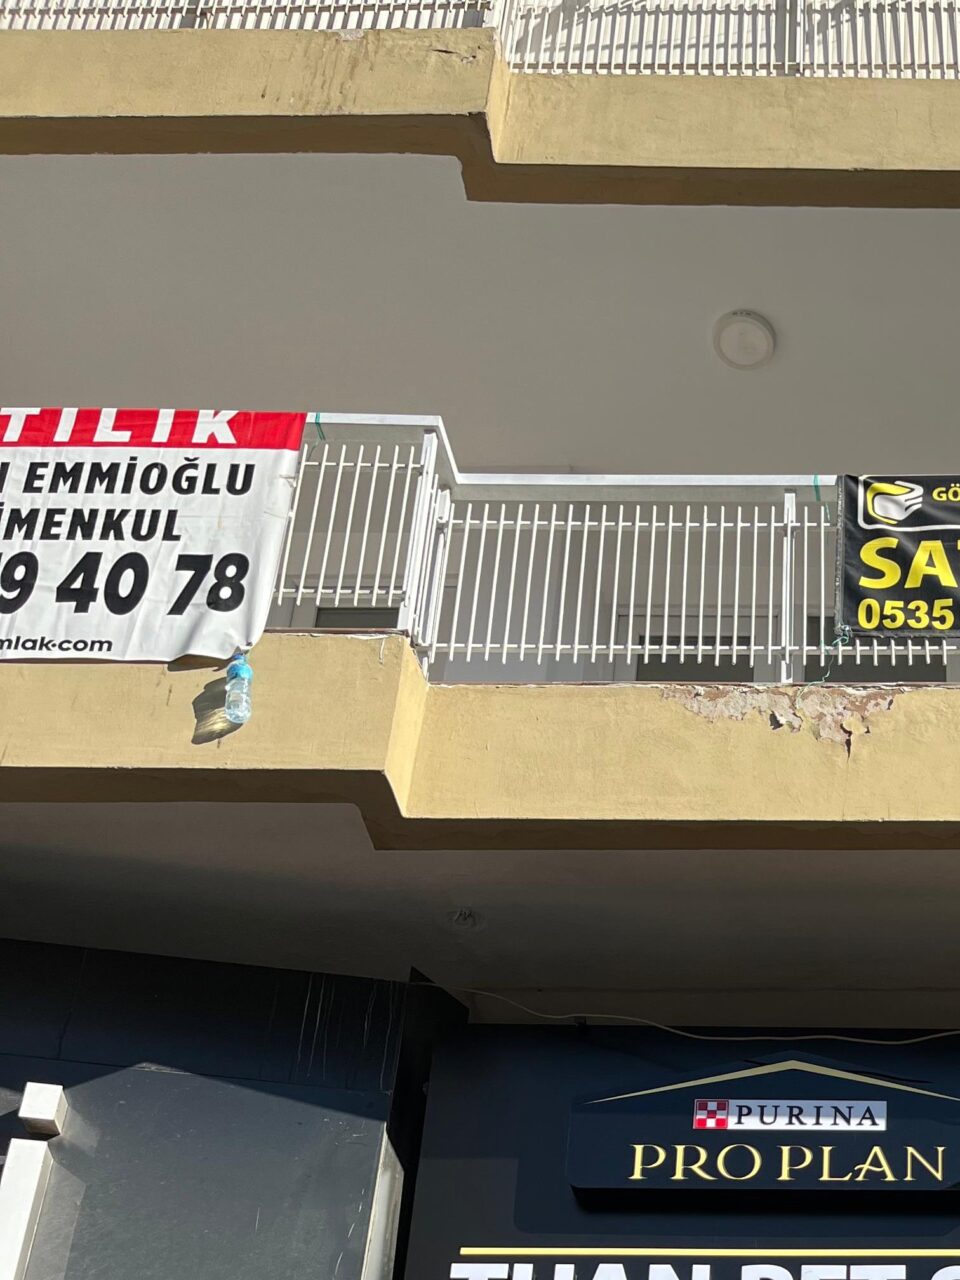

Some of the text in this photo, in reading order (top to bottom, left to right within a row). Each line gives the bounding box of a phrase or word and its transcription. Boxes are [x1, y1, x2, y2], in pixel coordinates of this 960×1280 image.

[22, 456, 255, 495] EMMİOĞLU
[55, 551, 149, 615] 40
[167, 553, 250, 615] 78
[857, 598, 955, 630] 0535
[735, 1104, 880, 1127] PURINA
[627, 1143, 947, 1182] PRO PLAN
